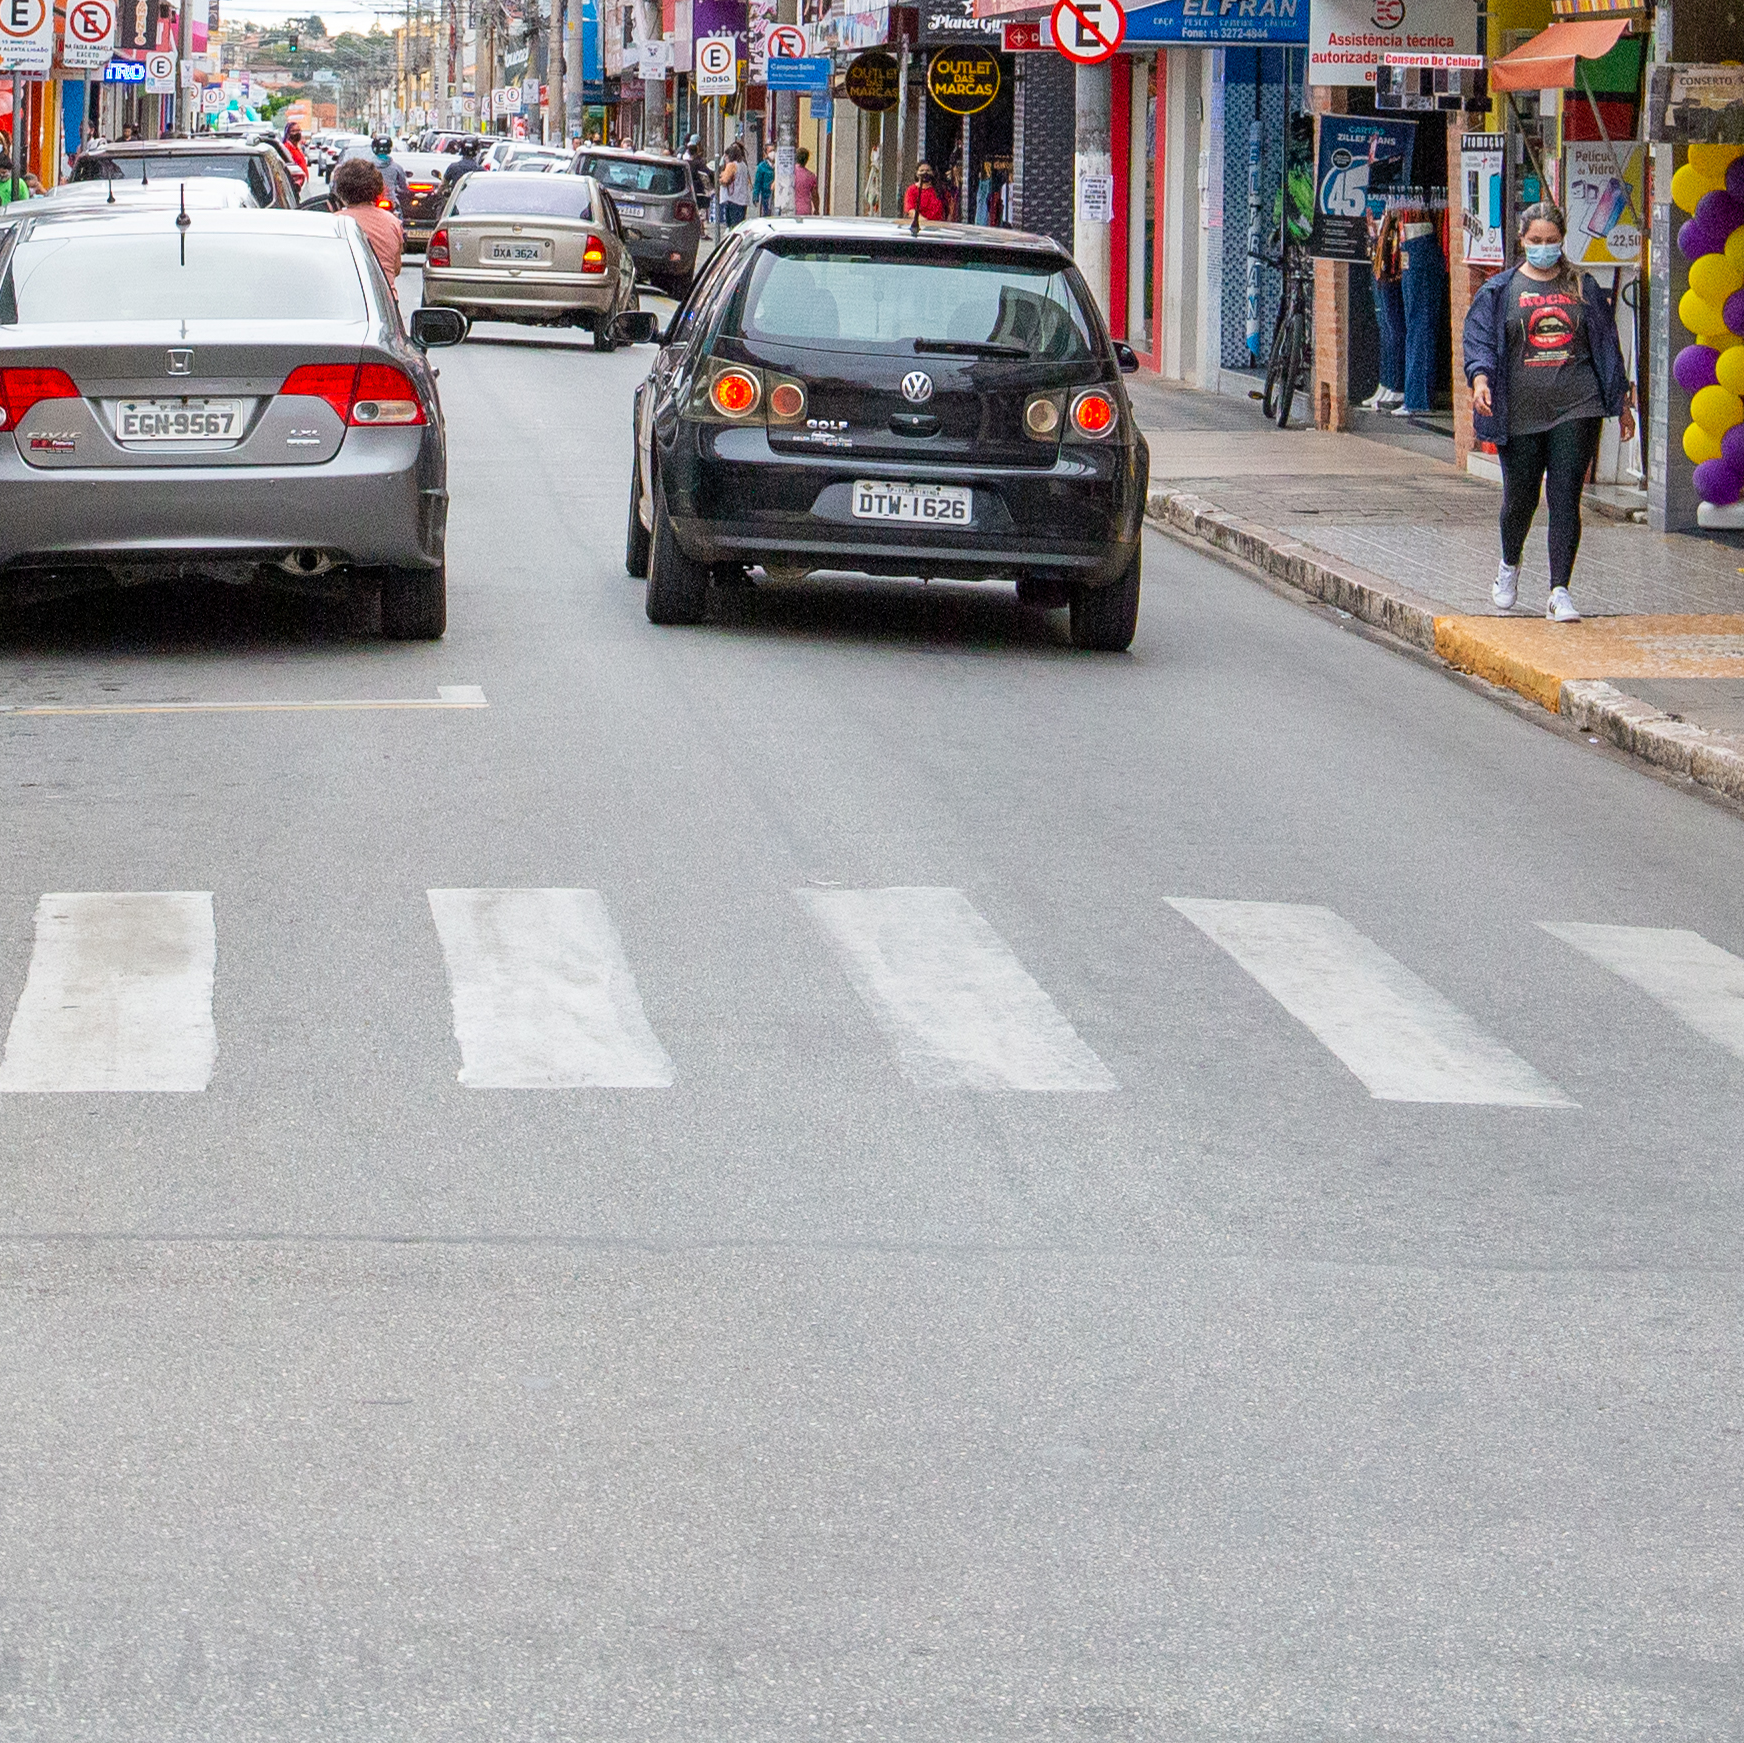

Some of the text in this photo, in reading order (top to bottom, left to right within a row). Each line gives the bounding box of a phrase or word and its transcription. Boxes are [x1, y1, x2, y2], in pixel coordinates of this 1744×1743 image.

[83, 10, 99, 33] E
[928, 14, 979, 31] Planet
[1076, 4, 1102, 47] E
[1182, 27, 1207, 39] Fone:
[1328, 32, 1455, 47] Assistência técnica
[710, 49, 721, 67] E
[1312, 50, 1378, 64] autorizada
[1385, 54, 1482, 68] Conserto De Celular
[156, 60, 166, 74] E
[937, 60, 992, 74] OUTLET
[703, 76, 730, 84] IDOSO
[953, 74, 975, 83] DAS
[1680, 74, 1733, 87] CONSERTO
[935, 83, 993, 95] MARCAS
[1588, 163, 1615, 175] Vidro
[1328, 165, 1366, 217] 45
[493, 247, 539, 259] DXA 3624
[806, 419, 848, 430] GOLF
[26, 431, 82, 439] CIVIC
